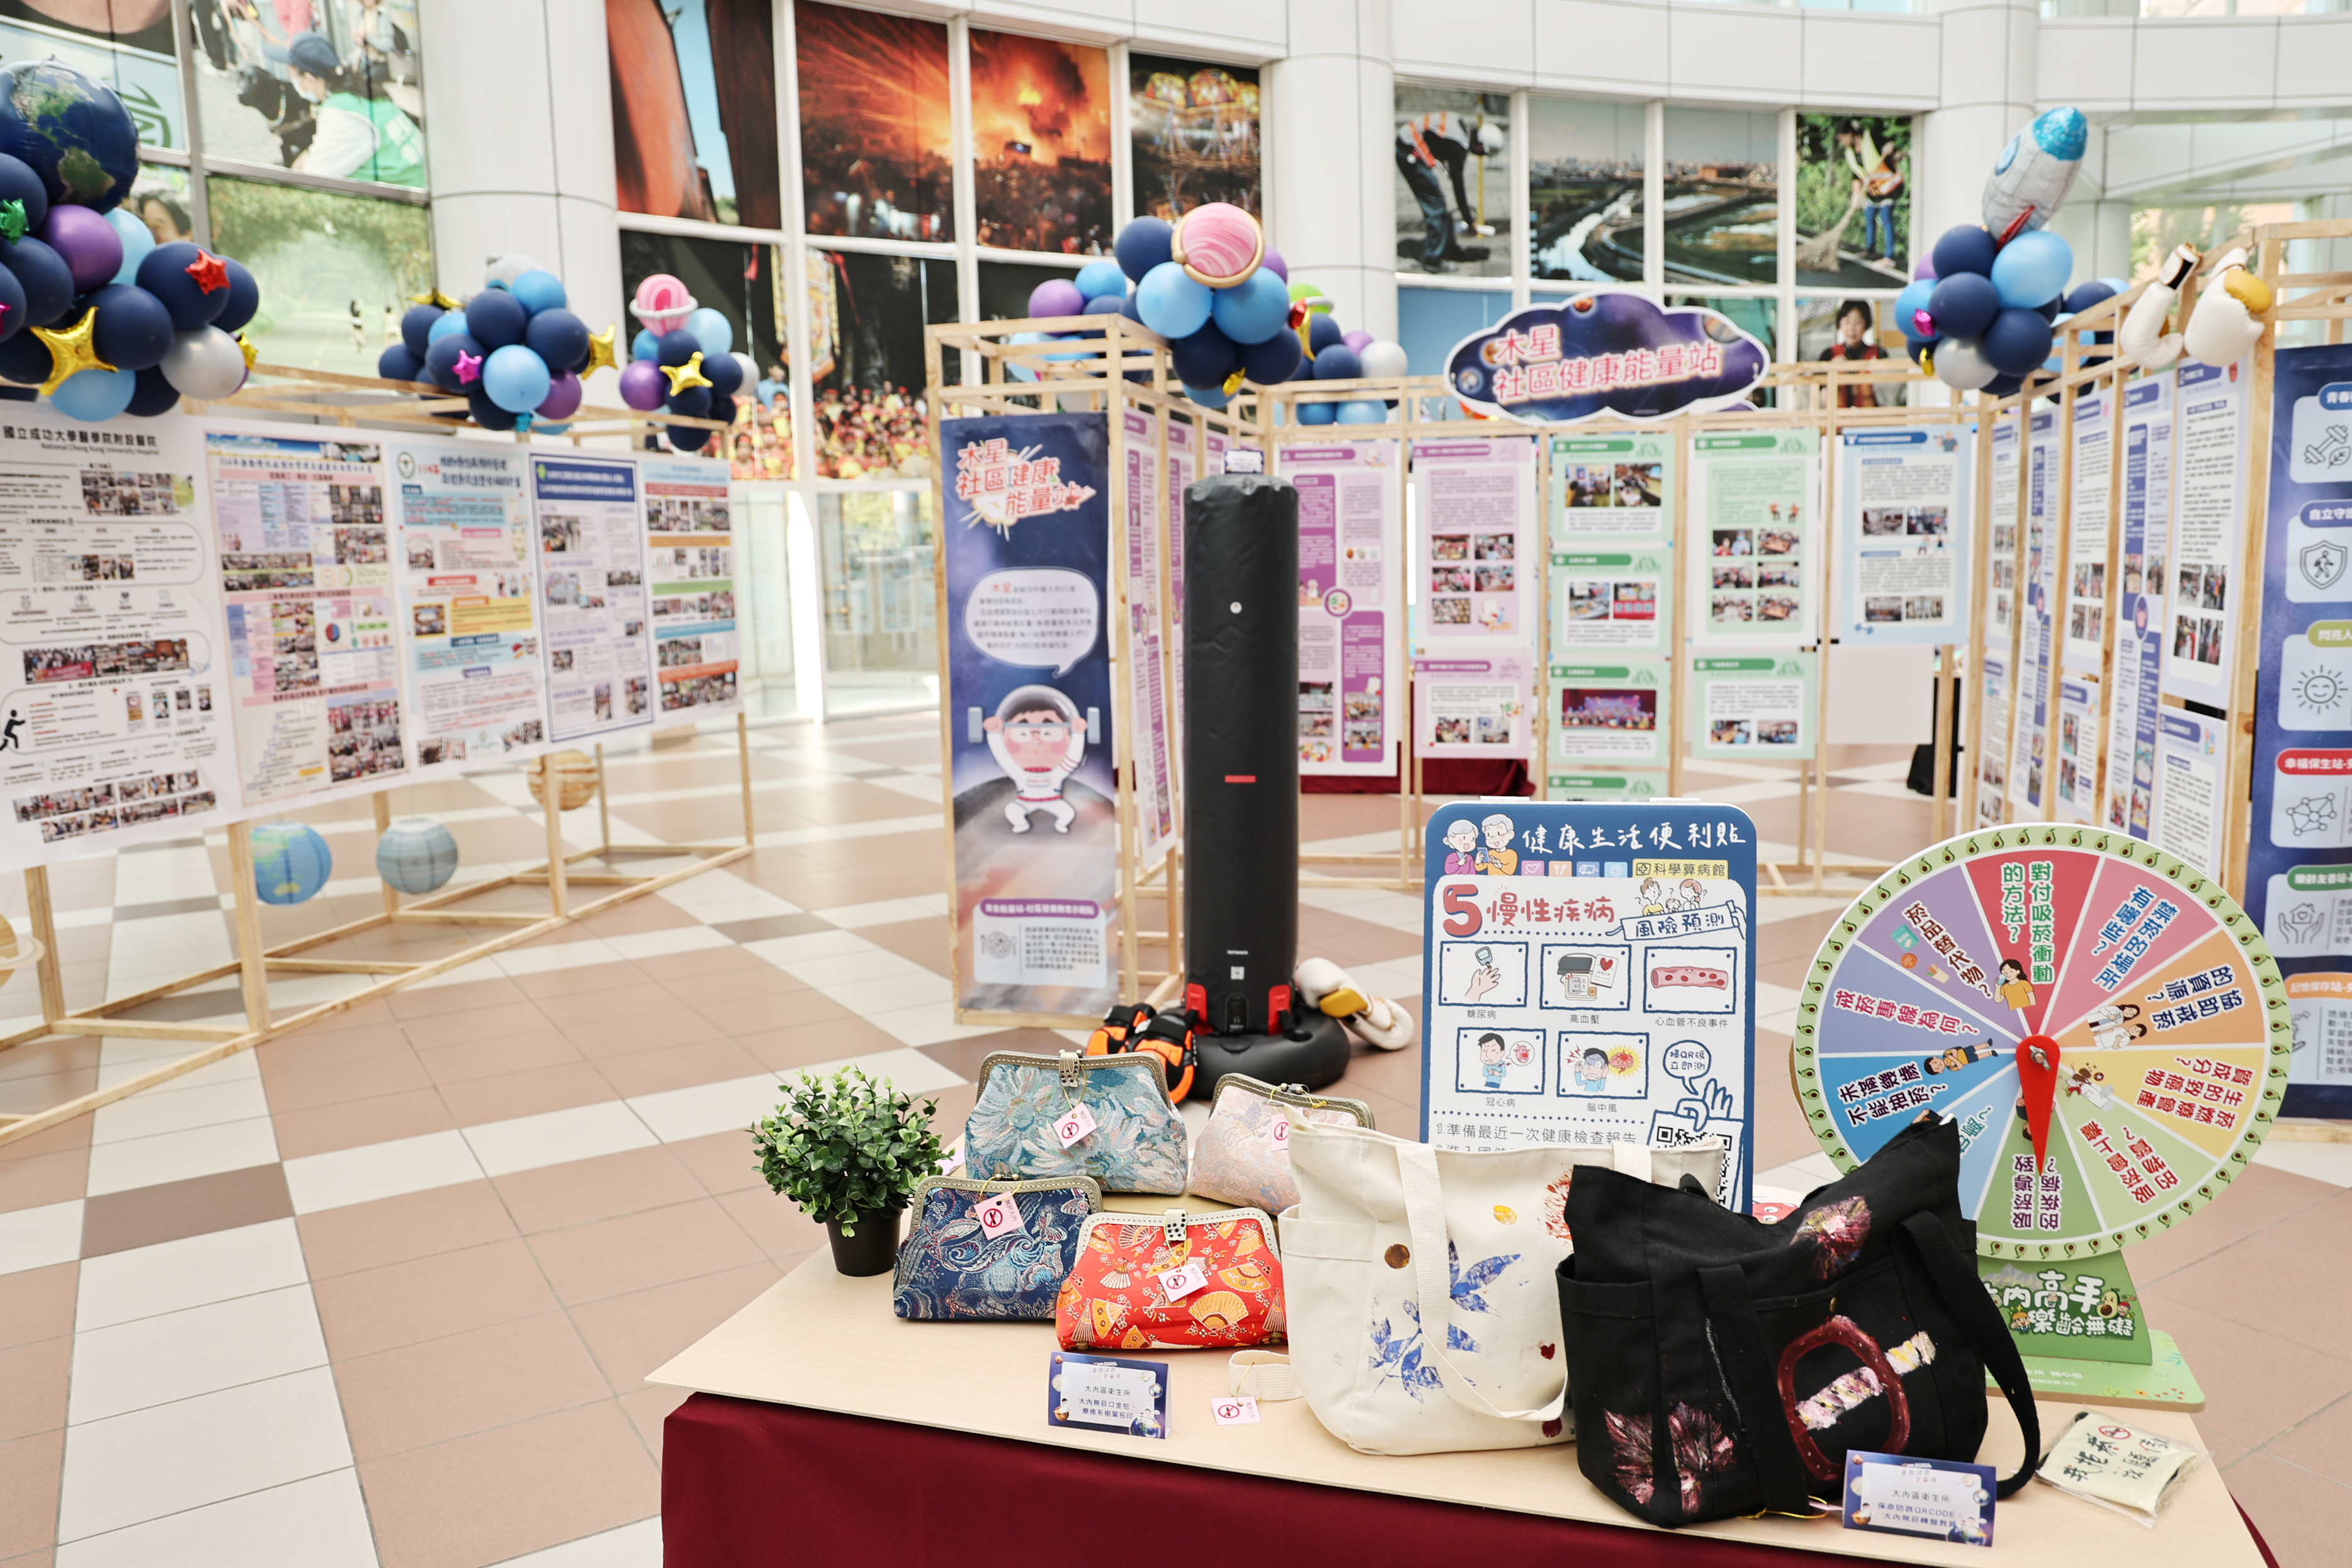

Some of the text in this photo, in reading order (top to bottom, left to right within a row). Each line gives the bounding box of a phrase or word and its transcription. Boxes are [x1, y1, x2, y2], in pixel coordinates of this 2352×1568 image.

[1495, 325, 1558, 363] 木星
[1493, 342, 1721, 401] 社區健康能量站
[2326, 391, 2352, 404] 青春
[957, 439, 1007, 469] 木星
[956, 458, 1056, 497] 社區健康
[1522, 821, 1748, 855] 健康生活便利貼
[1653, 862, 1726, 877] 科學算病館
[1635, 913, 1725, 938] 風險預測
[2030, 863, 2053, 983] 對付吸菸衝動
[1897, 933, 1910, 943] GUM
[2095, 900, 2178, 990] 禁菸的場所
[1467, 1009, 1497, 1020] 糖尿病
[1569, 1013, 1600, 1024] 高血壓
[1654, 1018, 1729, 1029] 心血管不良事件
[2152, 993, 2243, 1030] 協助戒菸
[1669, 1049, 1708, 1061] 掃QR碼
[1670, 1060, 1706, 1071] 立即測
[1840, 1064, 1921, 1102] 未滿幾歲
[2144, 1069, 2246, 1104] 生的致癌物
[1486, 1097, 1516, 1108] 冠心病
[1586, 1103, 1617, 1114] 腦中風
[2136, 1090, 2236, 1129] 菸燃燒會產
[2080, 1120, 2156, 1204] 吸菸會上癮
[2013, 1156, 2033, 1228] 吸菸導致
[2029, 1309, 2134, 1336] 樂齡無礙
[1085, 1385, 1131, 1397] 大內區衛生所
[1892, 1489, 1950, 1503] 大內區衛生所
